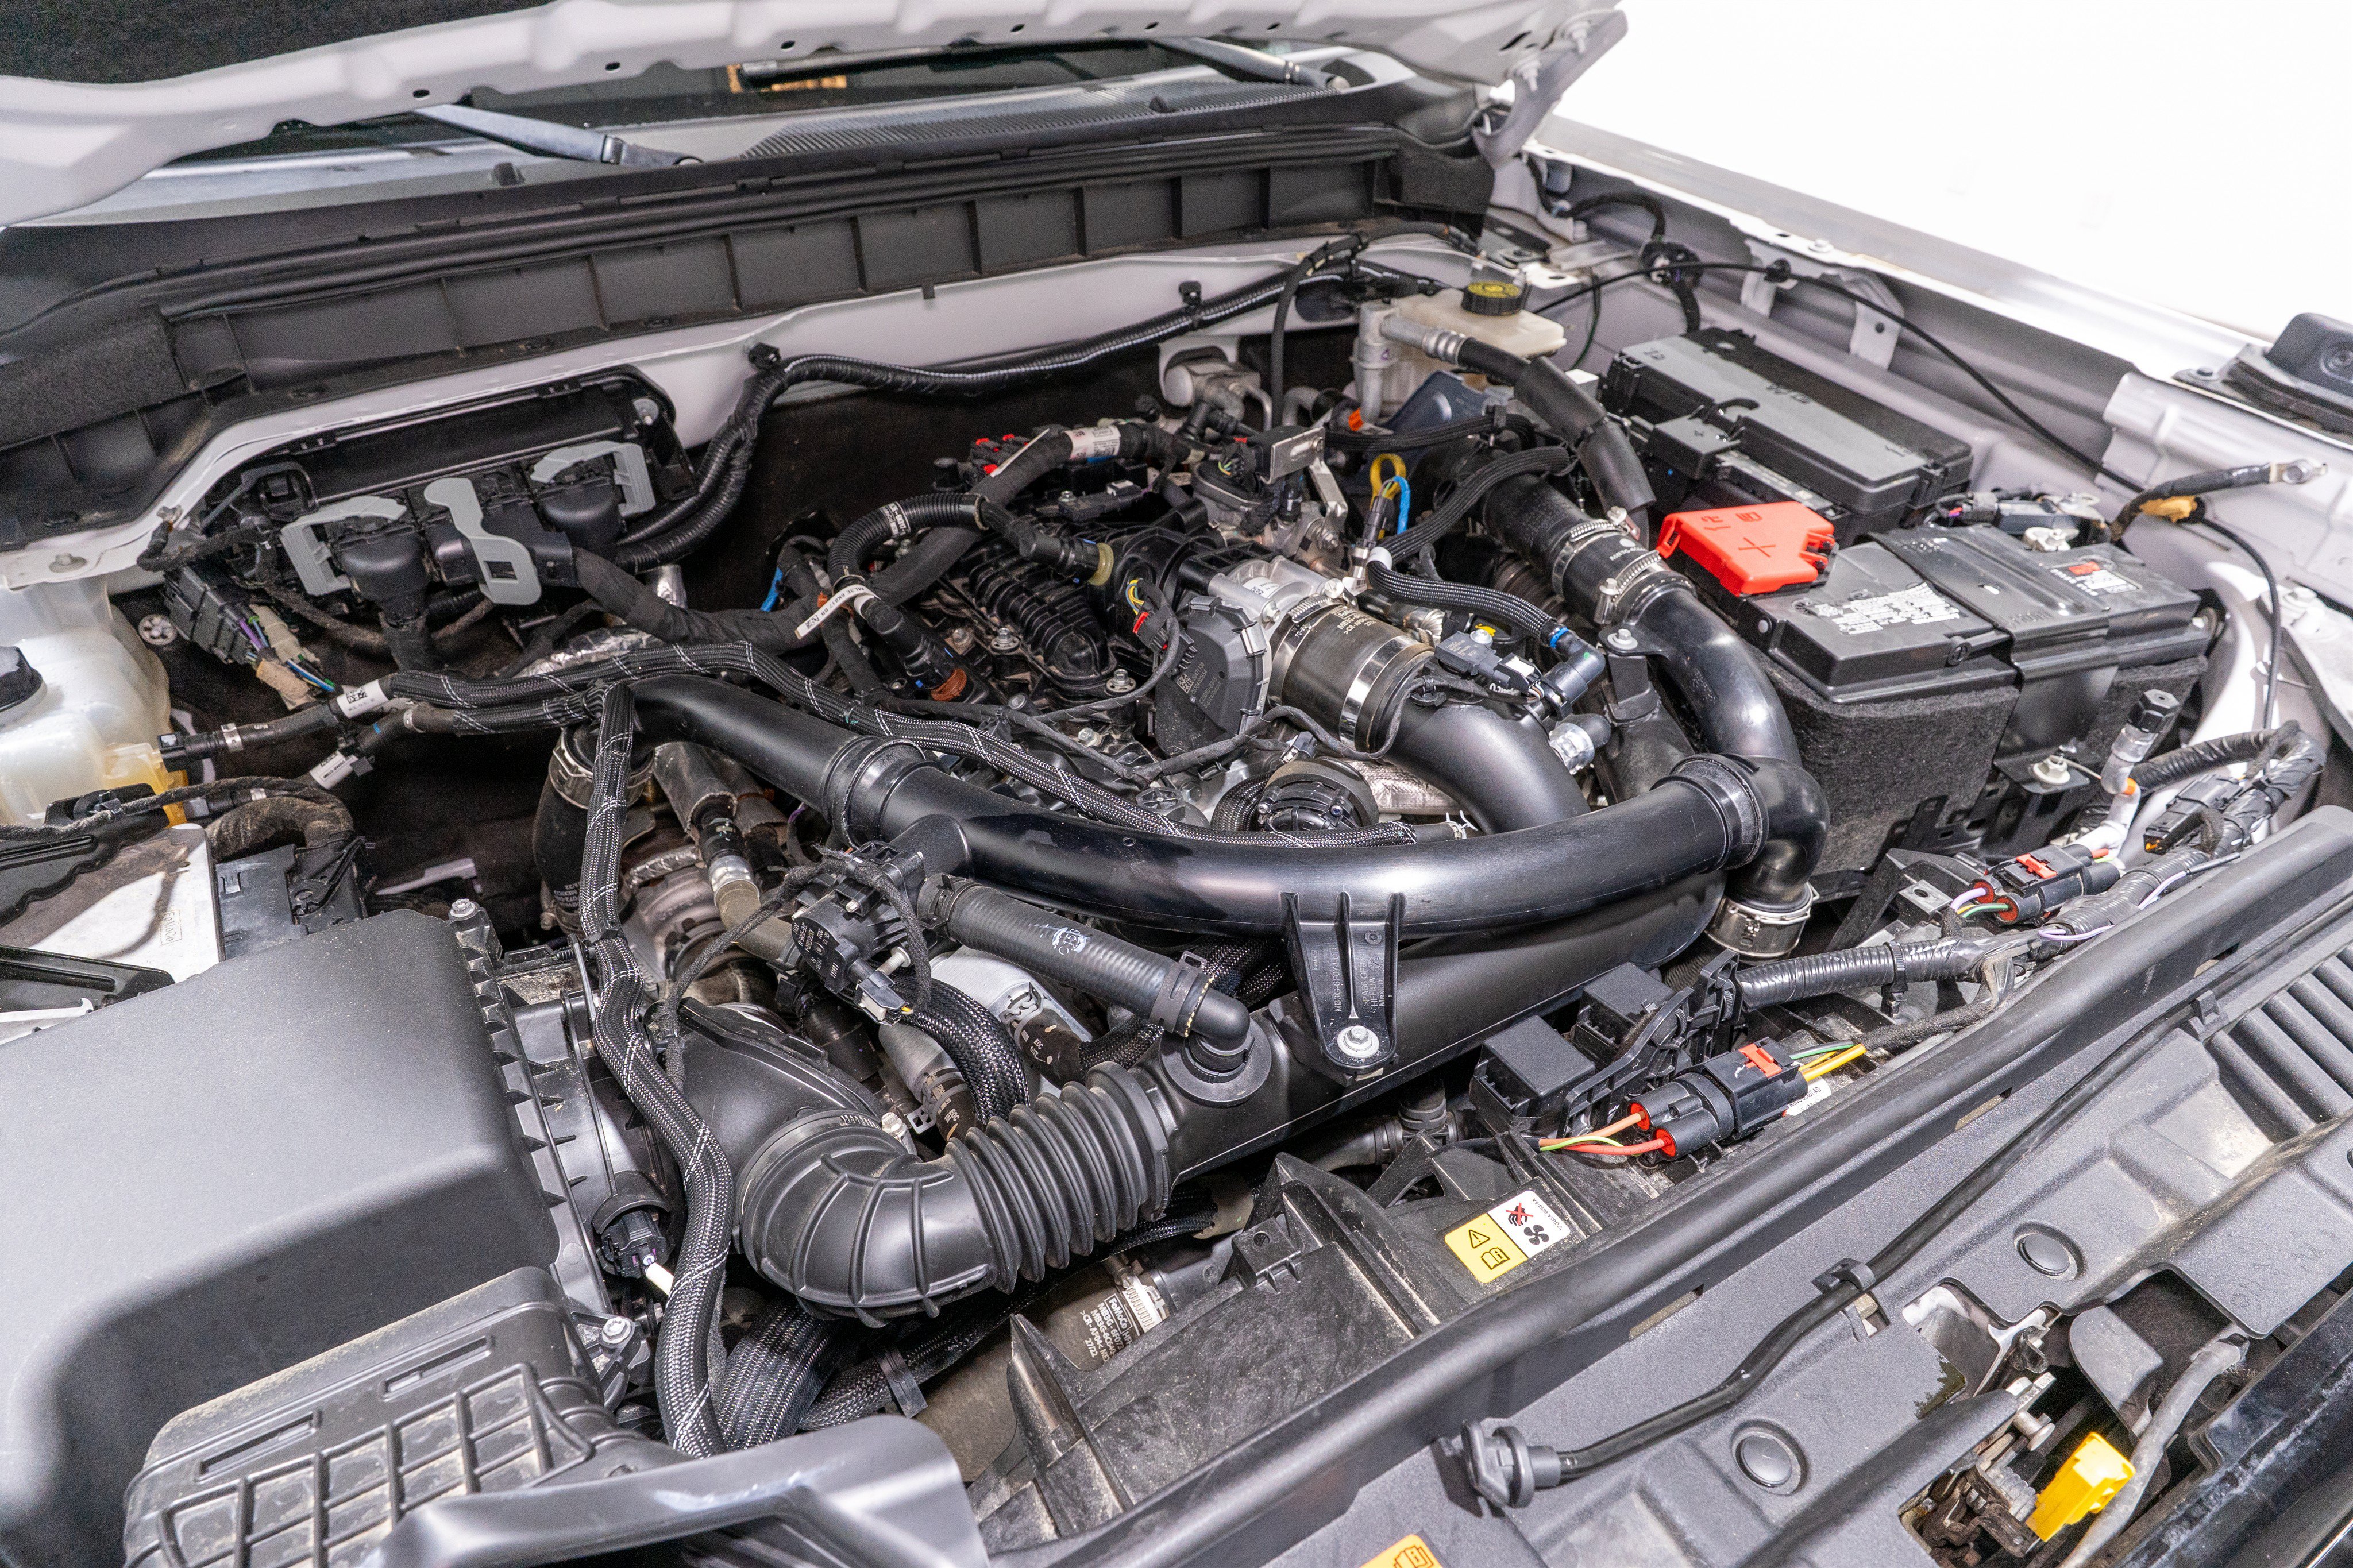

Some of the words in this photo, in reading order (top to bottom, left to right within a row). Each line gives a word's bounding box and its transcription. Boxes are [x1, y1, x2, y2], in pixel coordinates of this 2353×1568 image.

[827, 593, 846, 608] 6K817
[164, 912, 176, 942] FoMoCo
[1056, 926, 1081, 957] C156
[1033, 1038, 1043, 1049] EOC
[1031, 1046, 1039, 1057] OUT
[944, 1113, 952, 1123] IN
[948, 1107, 961, 1122] EOC
[1108, 1297, 1128, 1330] FoMoCo
[1085, 1338, 1098, 1358] 27/22
